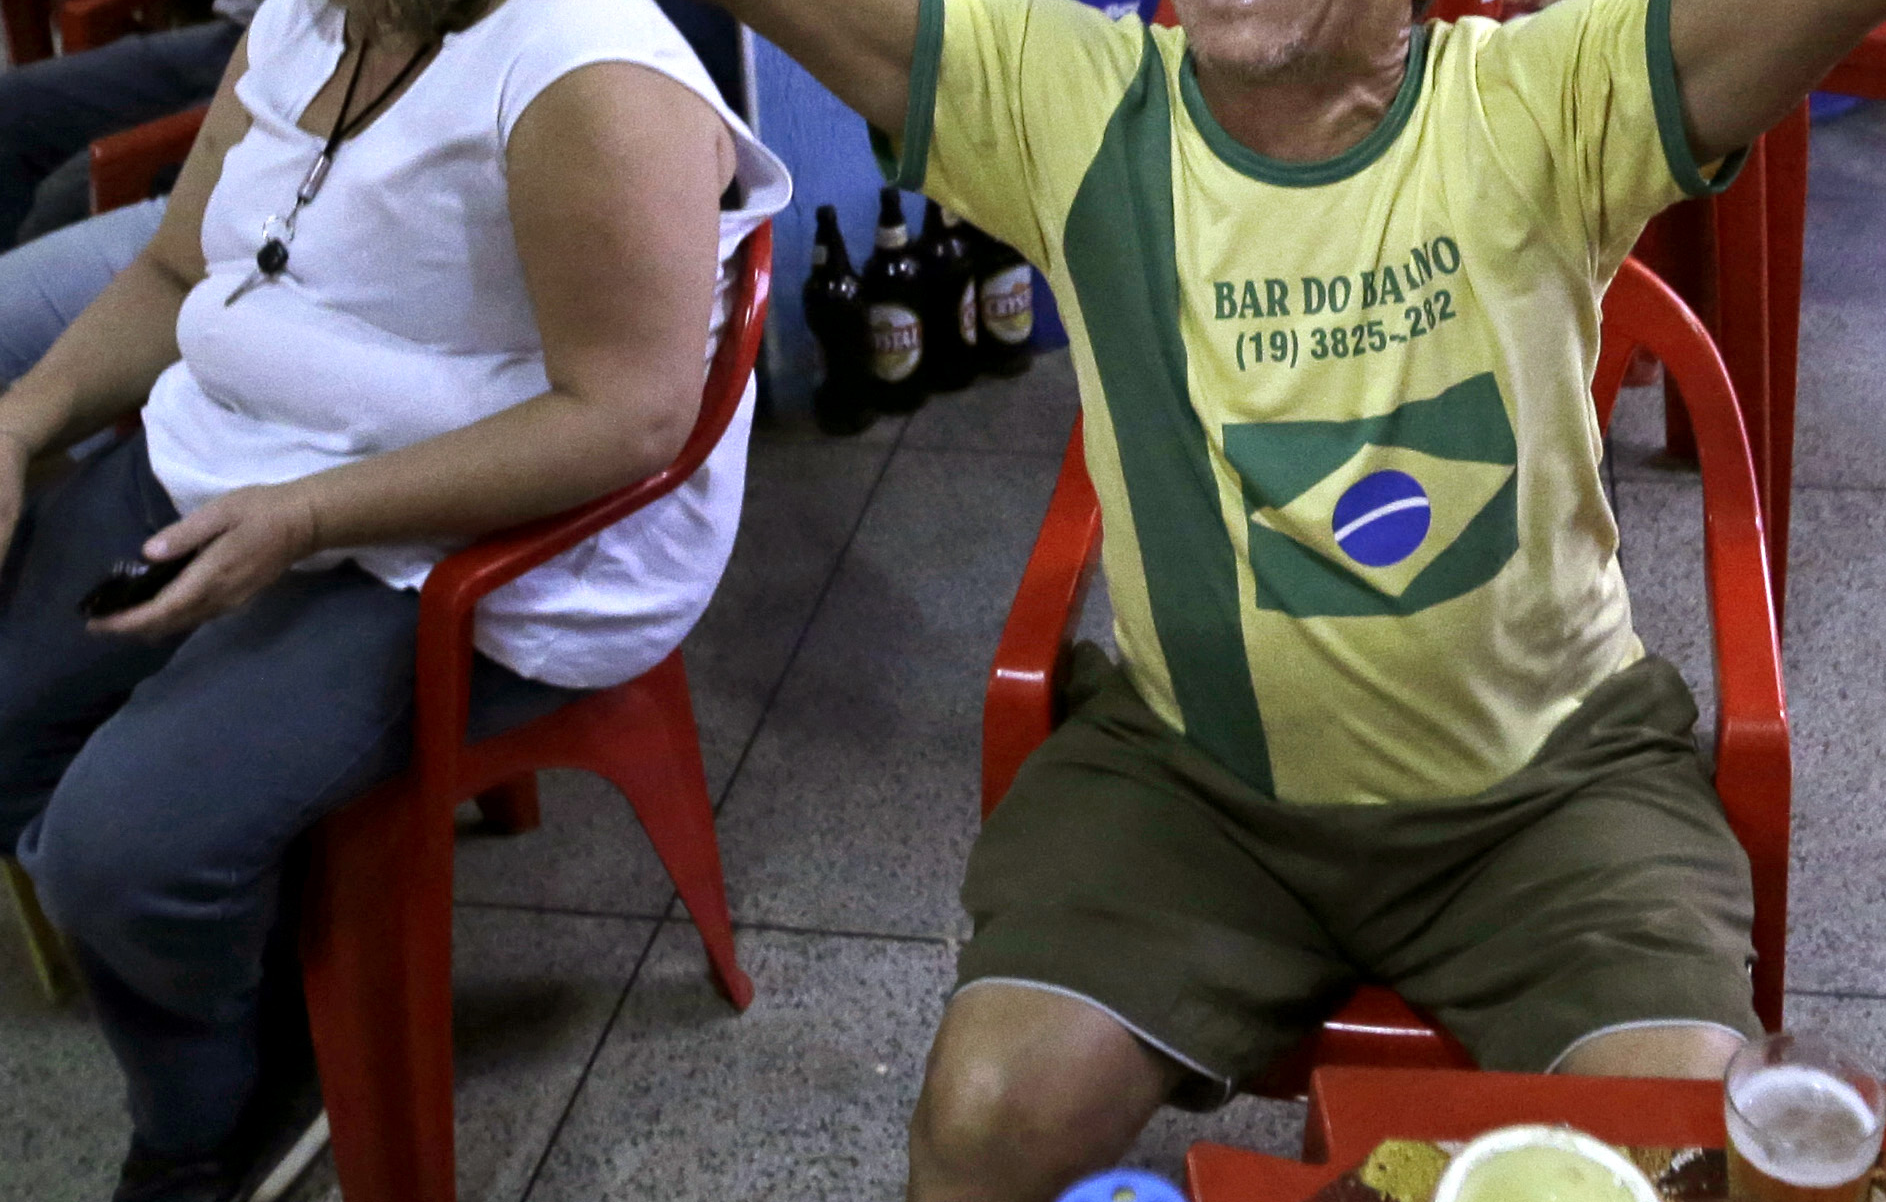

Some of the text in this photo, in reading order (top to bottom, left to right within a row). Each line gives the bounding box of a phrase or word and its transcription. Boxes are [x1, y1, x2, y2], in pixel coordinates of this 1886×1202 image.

[1213, 278, 1291, 320] BAR
[1301, 274, 1352, 315] DO
[1236, 329, 1299, 372] (19)
